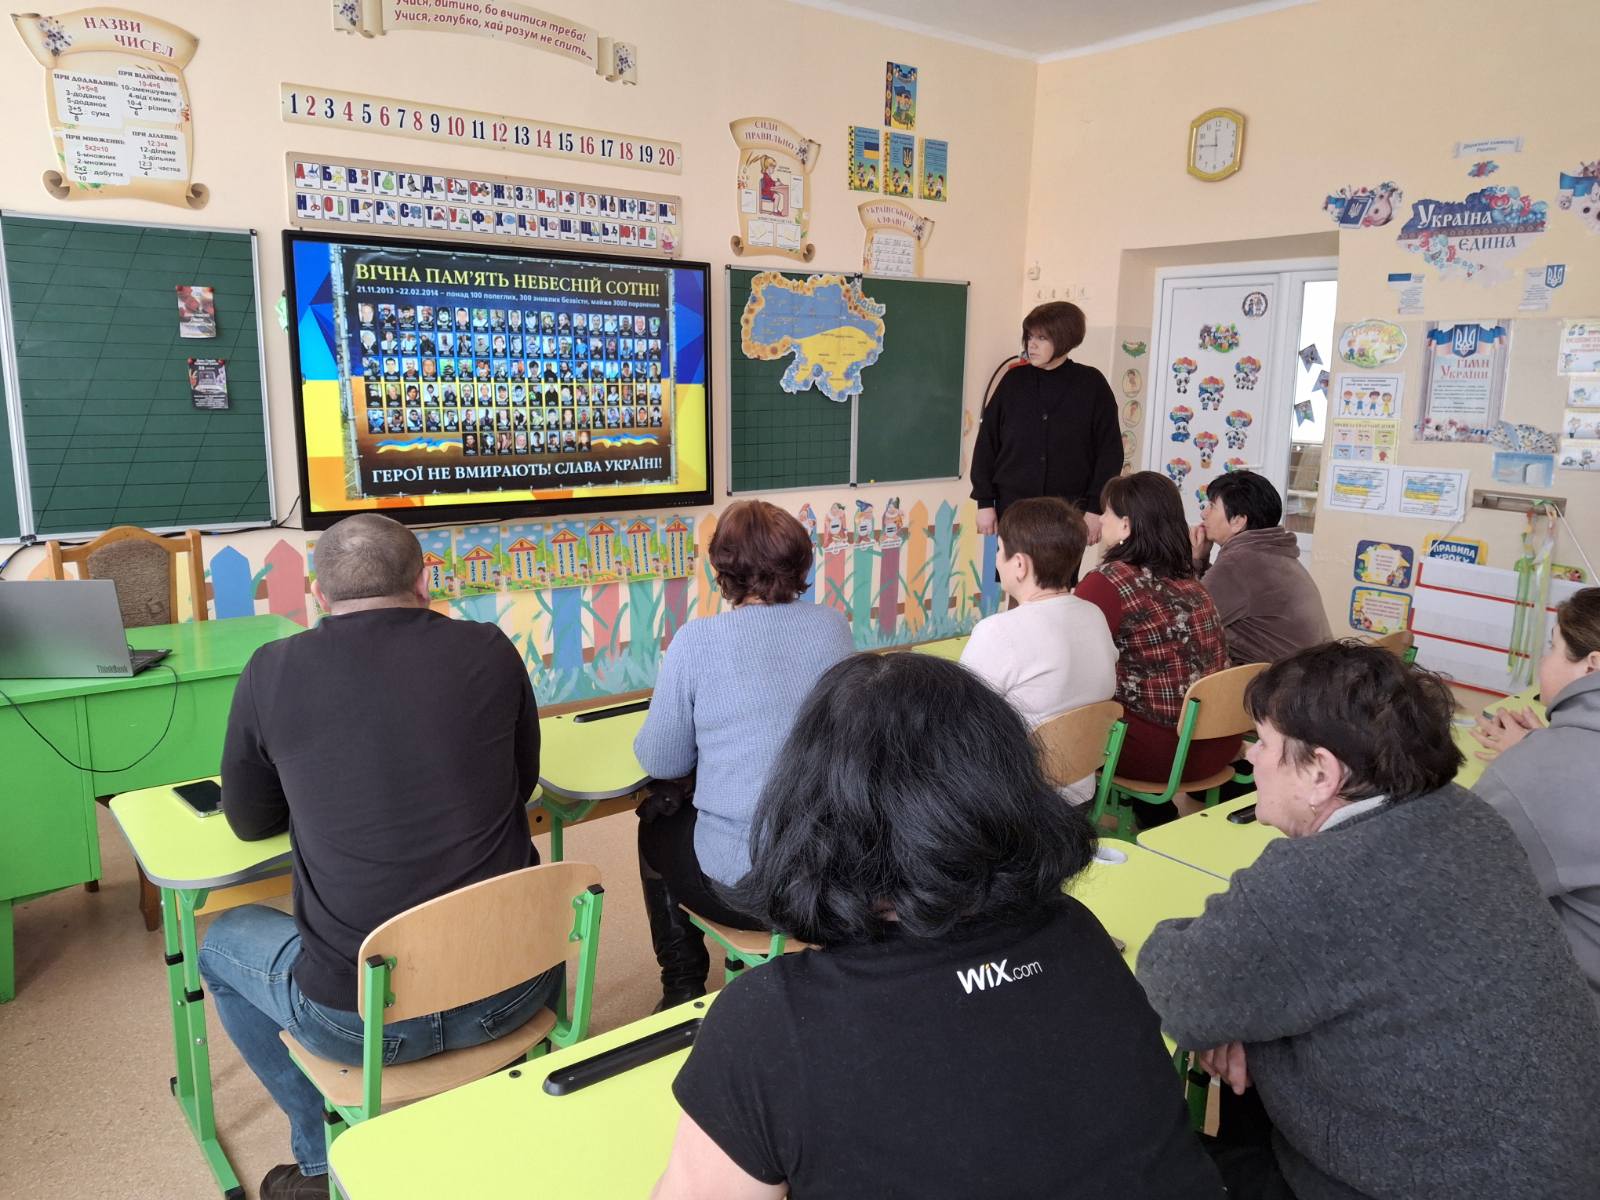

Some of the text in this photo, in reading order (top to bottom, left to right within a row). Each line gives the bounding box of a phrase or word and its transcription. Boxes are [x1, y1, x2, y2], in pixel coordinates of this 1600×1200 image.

[83, 16, 142, 33] НАЗВИ
[395, 10, 431, 22] Учися,
[434, 15, 481, 28] голубко,
[484, 20, 503, 31] хай
[505, 25, 538, 40] розум
[541, 34, 553, 44] не
[435, 0, 482, 13] дитино,
[485, 3, 498, 16] бо
[501, 9, 547, 28] вчитися
[549, 22, 586, 42] треба!
[114, 34, 174, 57] ЧИСЕЛ
[290, 93, 675, 166] 1 2 3 4 5 6 7 8 9 10 11 12 13 14 15 16 17 18 19 20
[745, 132, 794, 149] ПРАВИЛЬНО
[296, 164, 305, 179] А
[322, 166, 332, 181] Б
[348, 169, 357, 183] В
[374, 172, 381, 186] Г
[423, 177, 433, 193] Д
[448, 179, 453, 193] Е
[494, 185, 504, 199] Ж
[516, 187, 523, 201] З
[538, 189, 545, 203] И
[660, 204, 667, 217] М
[297, 195, 307, 210] Н
[324, 197, 333, 212] О
[351, 199, 359, 213] П
[376, 201, 384, 215] Р
[400, 203, 409, 218] С
[426, 206, 433, 220] Т
[449, 207, 457, 222] У
[472, 211, 484, 224] Ф
[518, 215, 527, 231] Ц
[540, 217, 548, 231] Ч
[560, 220, 571, 232] Ш
[581, 221, 592, 236] Щ
[602, 223, 609, 236] Ь
[1459, 236, 1516, 252] ЄДИНА
[355, 264, 421, 282] ВІЧНА
[514, 274, 602, 293] НЕБЕСНІЙ
[606, 281, 659, 296] СОТНІ!
[356, 286, 394, 294] 21.11.2013
[372, 458, 662, 482] ГЕРОЇ НЕ ВМИРАЮТЬ! СЛАВА УКРАЇНІ!
[1434, 544, 1475, 558] ПРАВИЛА
[97, 665, 128, 673] ThinkBook
